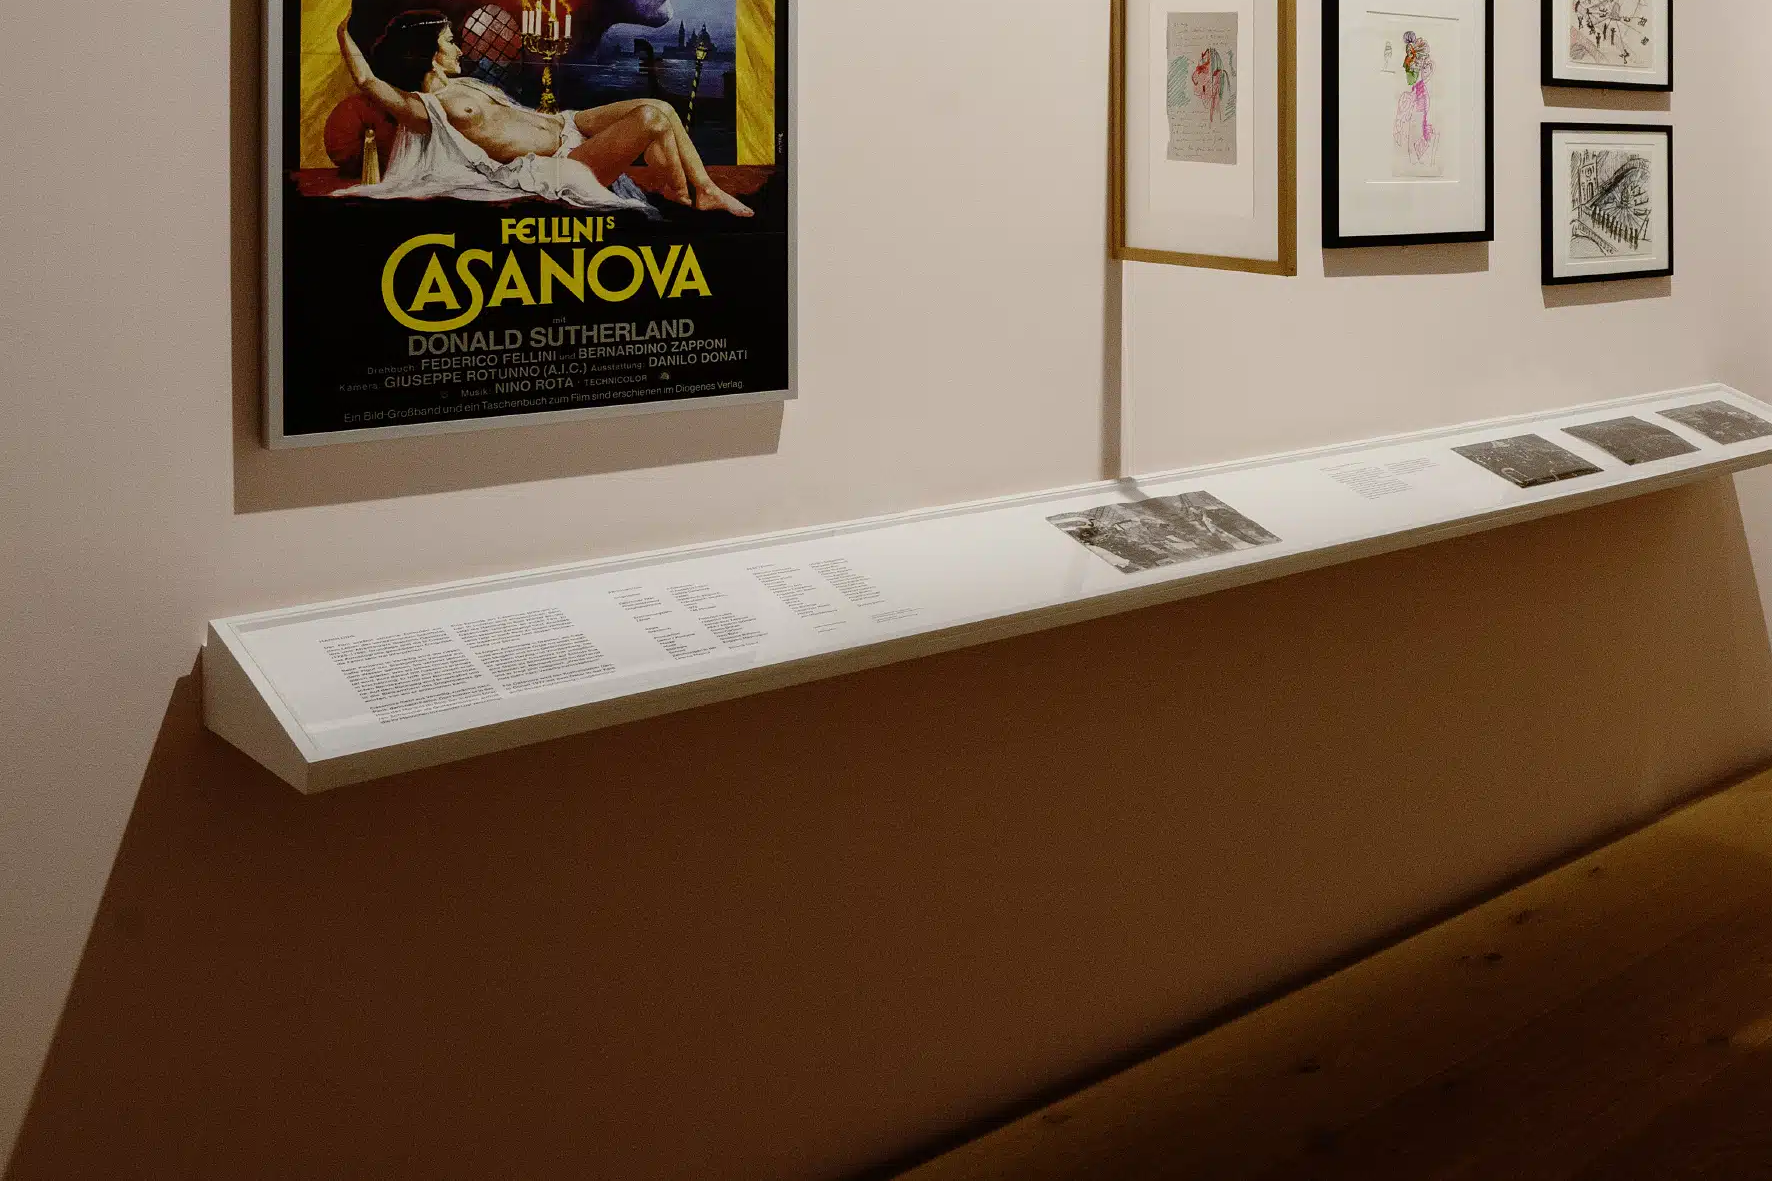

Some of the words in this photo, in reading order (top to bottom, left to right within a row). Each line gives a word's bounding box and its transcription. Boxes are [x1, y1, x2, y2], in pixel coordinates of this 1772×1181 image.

[381, 233, 713, 332] CASANOVA
[408, 329, 523, 356] DONALD
[529, 319, 695, 348] SUTHERLAND
[552, 316, 566, 324] mit
[384, 371, 462, 389] GIUSEPPE
[466, 365, 540, 382] ROTUNNO
[543, 362, 587, 378] (A.I.C.)
[648, 354, 697, 368] DANILO
[701, 350, 748, 364] DONATI
[421, 354, 498, 370] FEDERICO
[502, 351, 557, 365] FELLINI
[578, 342, 667, 359] BERNARDINO
[670, 338, 727, 353] ZAPPONI
[344, 412, 361, 423] Ein
[443, 403, 463, 414] und
[464, 403, 480, 412] ein
[481, 396, 548, 410] Taschenbuch
[548, 395, 569, 405] zum
[571, 392, 590, 403] Film
[591, 391, 611, 401] sind
[612, 386, 662, 399] erschienen
[663, 386, 674, 394] im
[675, 382, 716, 394] Diogenes
[495, 379, 531, 394] NINO
[535, 377, 574, 391] ROTA
[584, 374, 648, 387] TECHNICOLOR
